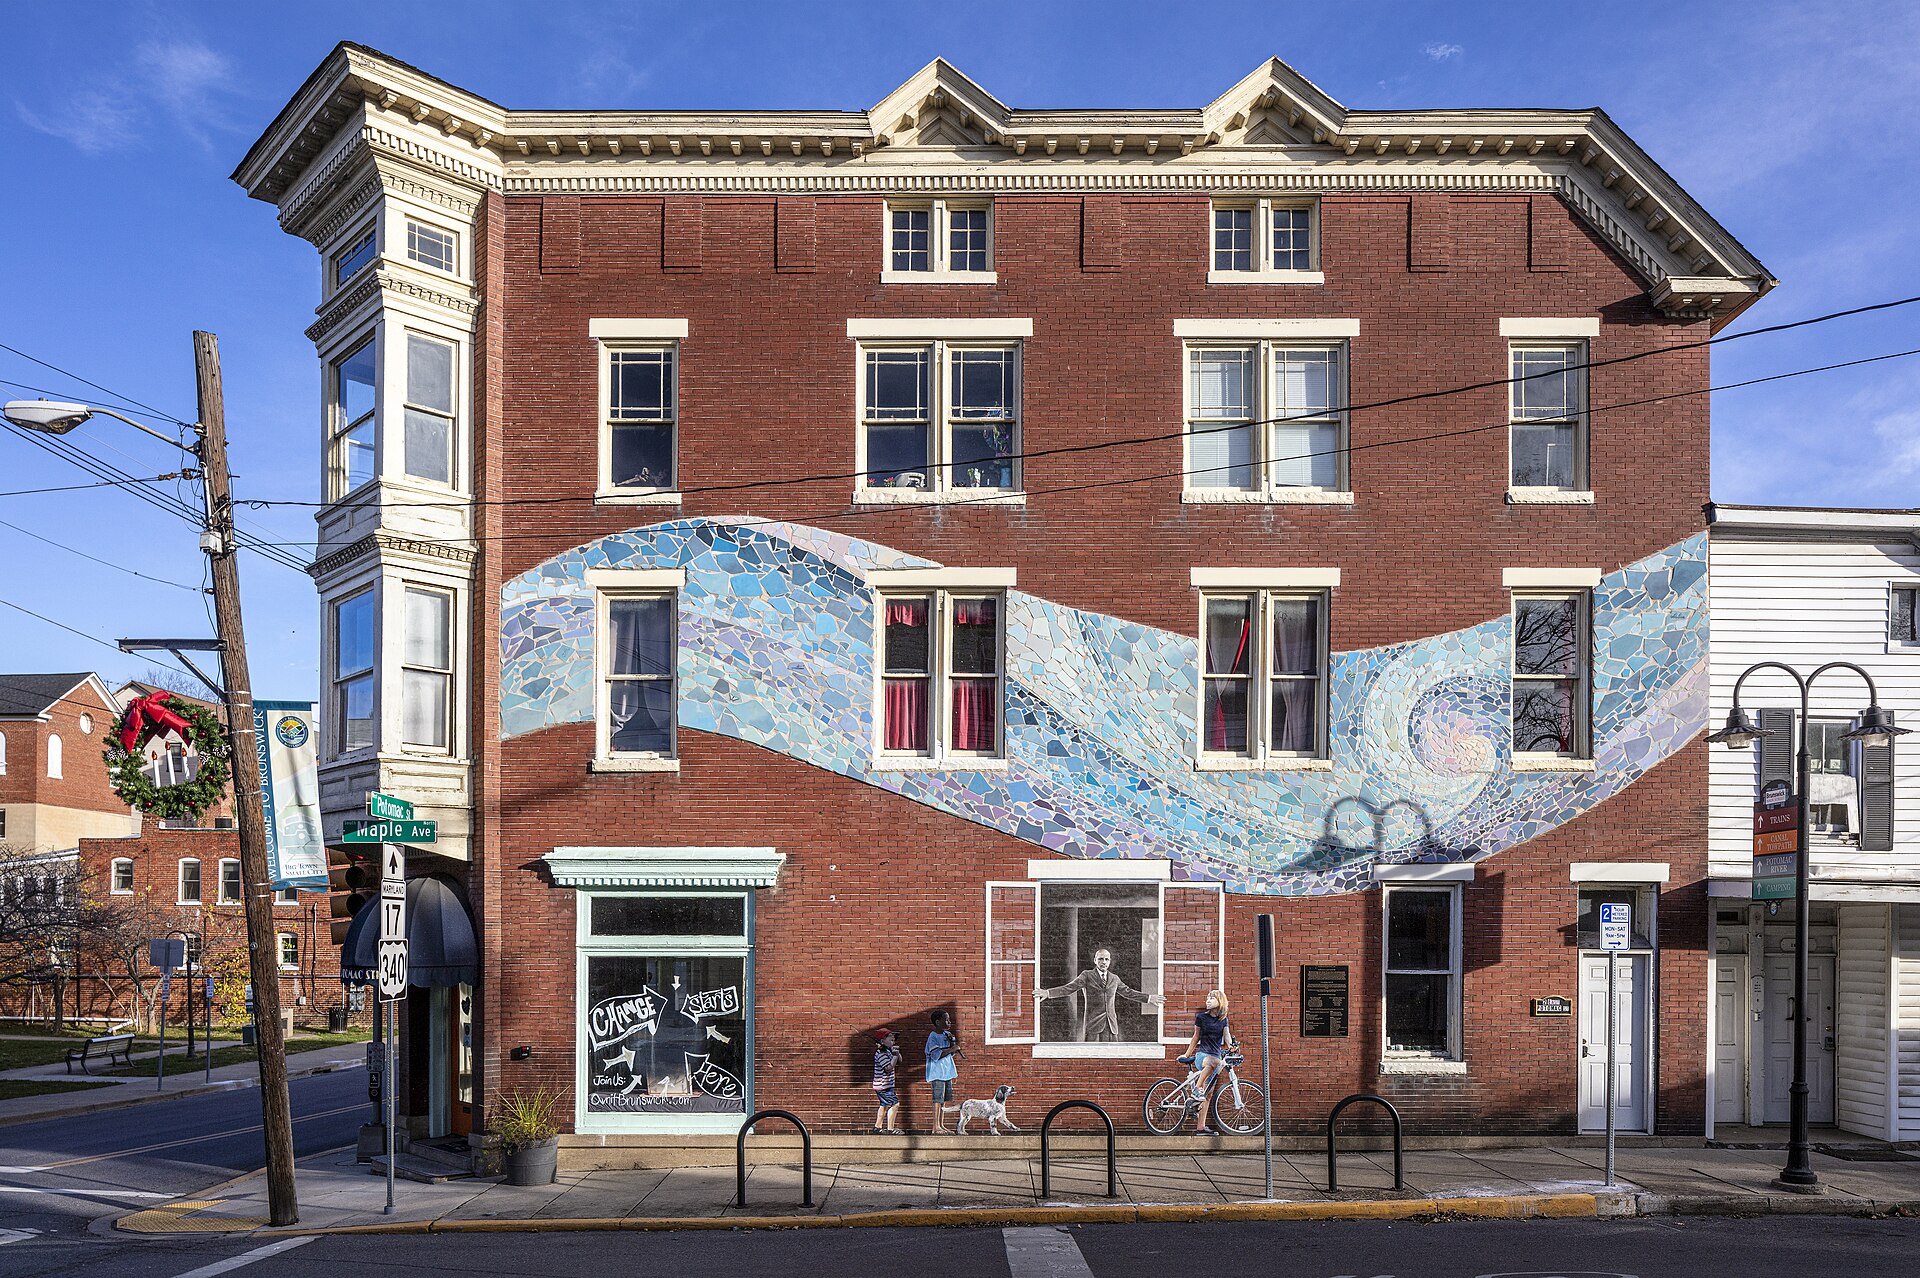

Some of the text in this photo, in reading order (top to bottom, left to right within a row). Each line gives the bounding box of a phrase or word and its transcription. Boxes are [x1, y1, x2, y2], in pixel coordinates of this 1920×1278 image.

[252, 707, 277, 880] WELCOME TO BRUNSWICK
[1766, 790, 1785, 799] Brunswick
[377, 796, 404, 818] Potomac
[406, 808, 411, 820] St
[1769, 814, 1791, 825] TRAINS
[356, 820, 431, 842] Maple Ave
[1770, 833, 1788, 843] CANAL
[1767, 841, 1792, 851] TOWPATH
[1766, 856, 1793, 865] POTOMAC
[1770, 865, 1788, 874] RIVER
[383, 884, 404, 895] MARYLAND
[1766, 883, 1791, 893] CAMPING
[1603, 907, 1610, 920] 2
[385, 903, 401, 936] 17
[381, 952, 405, 987] 340
[592, 988, 737, 1098] CHANGE Starts Here
